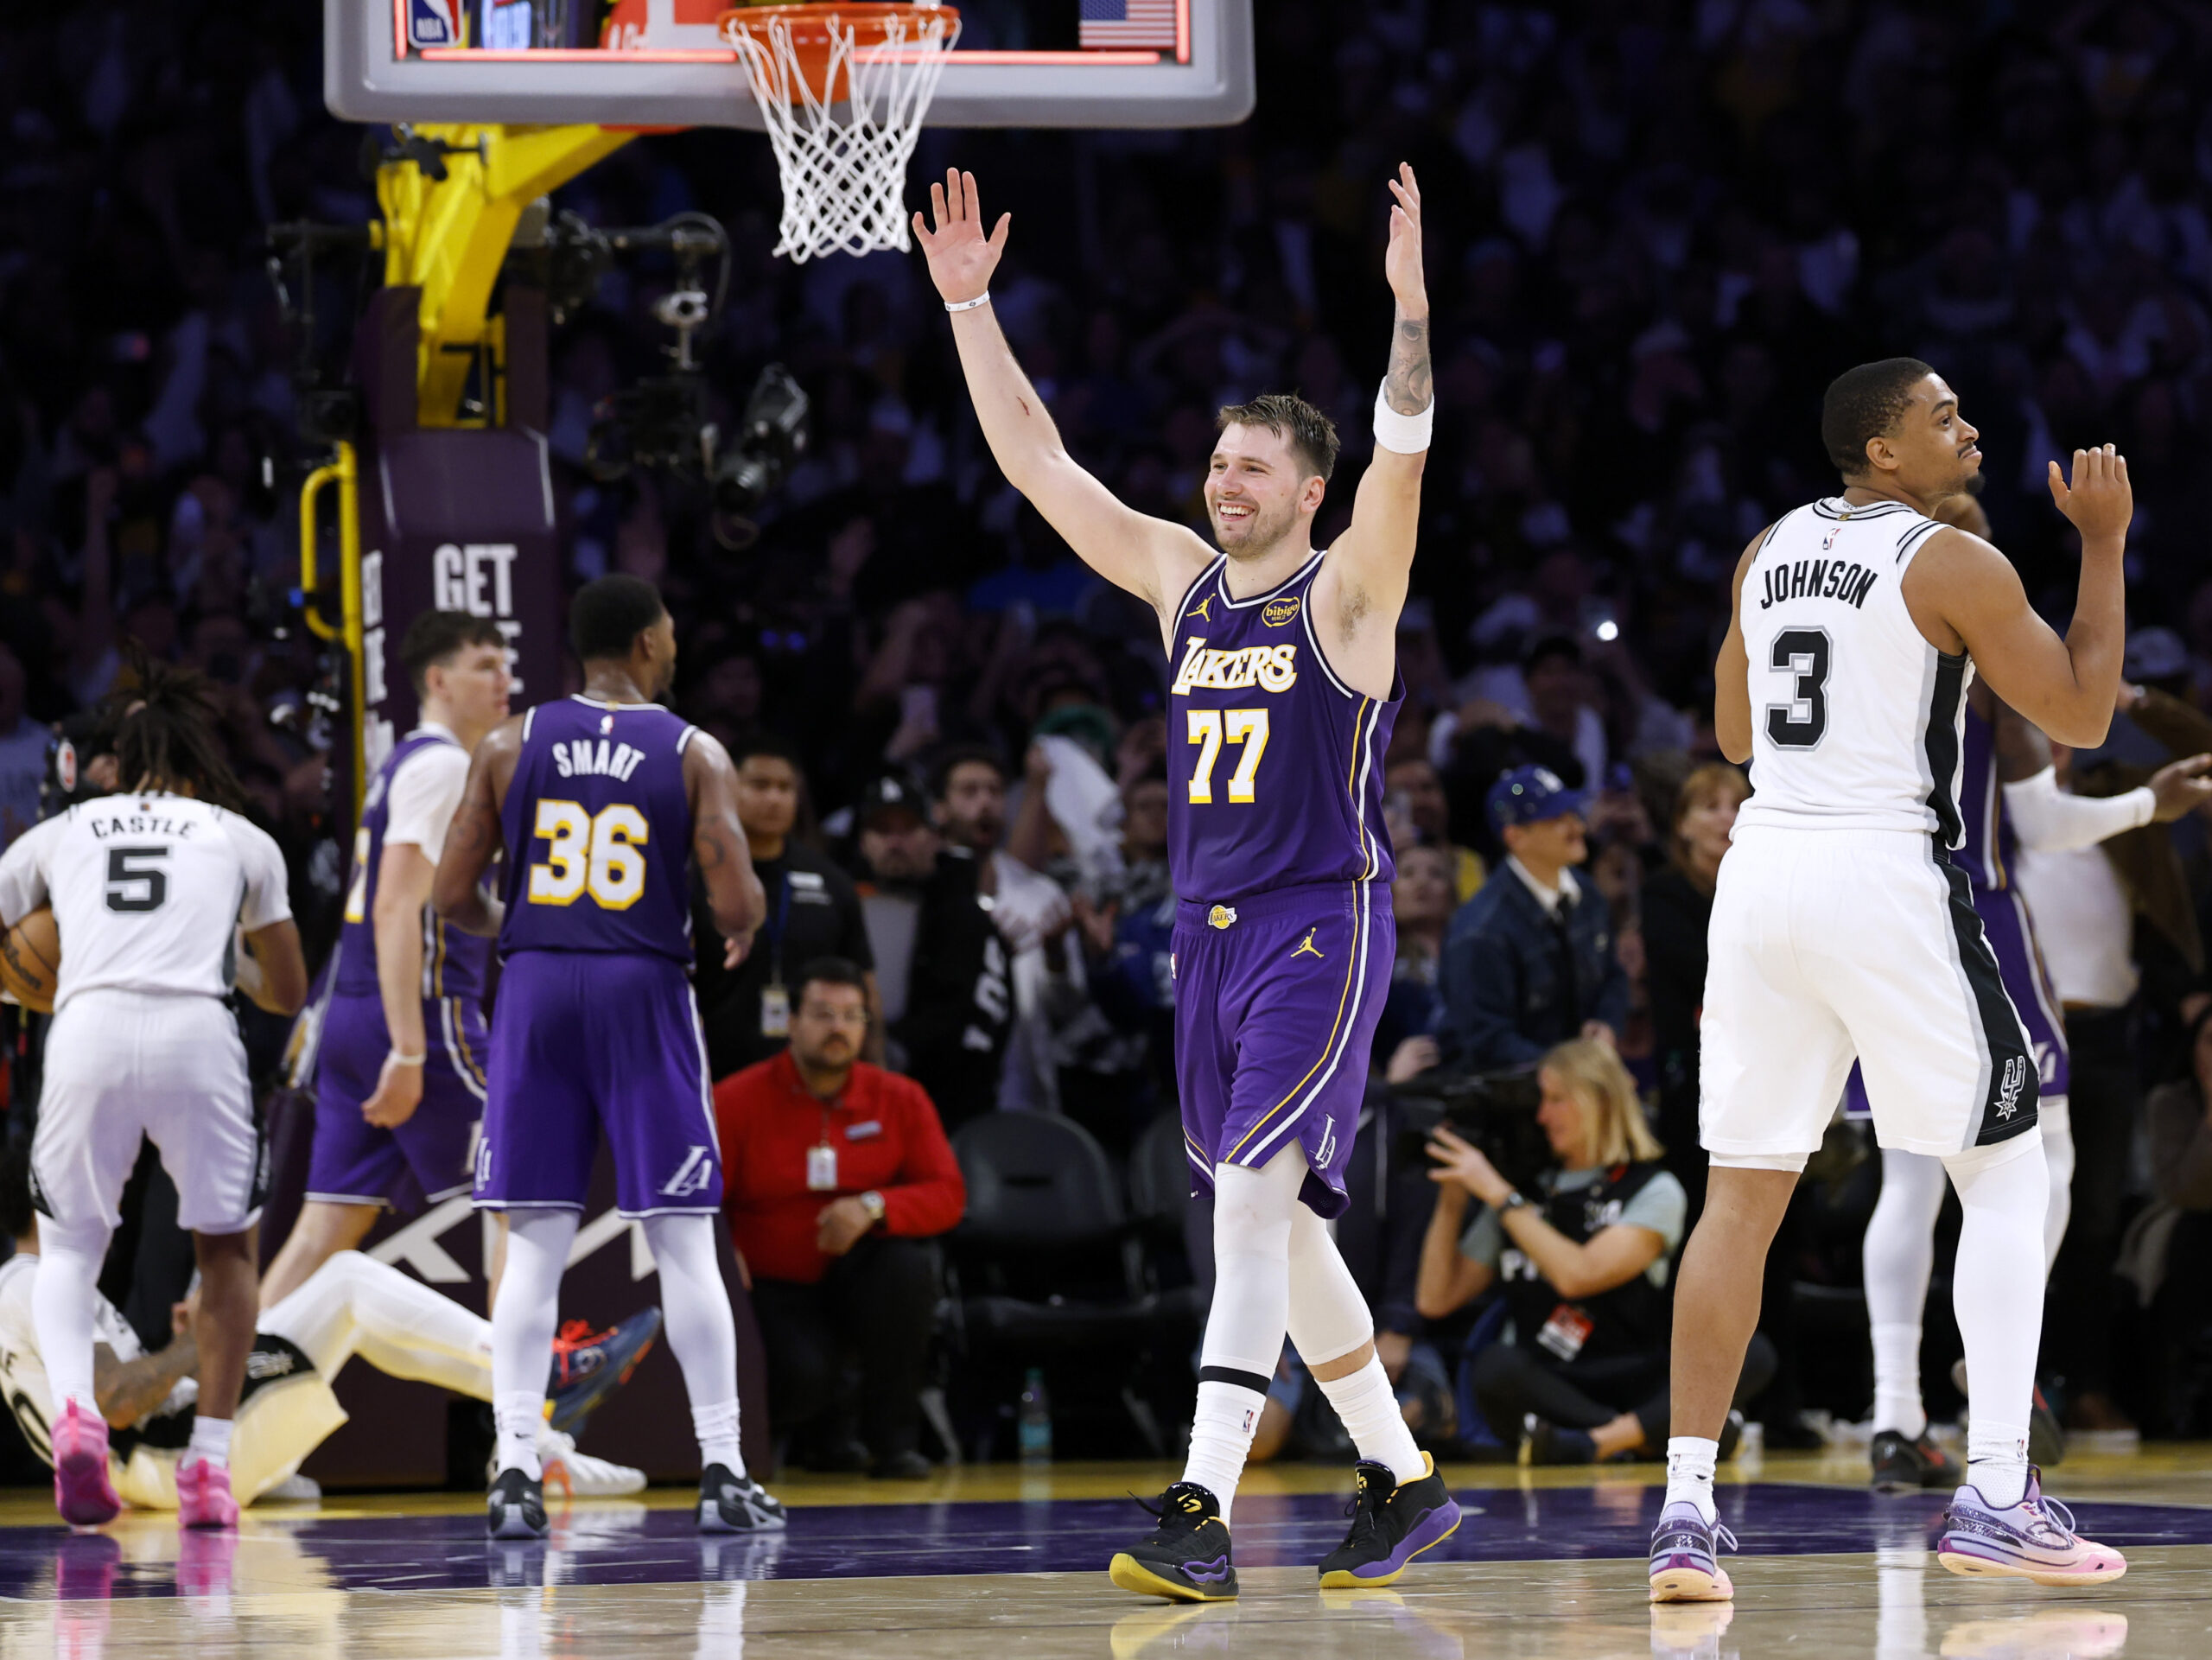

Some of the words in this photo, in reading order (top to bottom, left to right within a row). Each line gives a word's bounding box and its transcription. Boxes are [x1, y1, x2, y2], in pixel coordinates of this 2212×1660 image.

[416, 17, 445, 40] NBA
[434, 543, 518, 617] GET
[1760, 559, 1878, 610] JOHNSON
[1266, 604, 1298, 616] bibigo
[1172, 636, 1297, 696] LAKERS
[1764, 625, 1834, 752] 3
[552, 741, 646, 782] SMART
[1187, 708, 1269, 804] 77
[92, 816, 197, 840] CASTLE
[528, 798, 649, 912] 36
[104, 845, 172, 916] 5
[655, 1145, 714, 1197] LA
